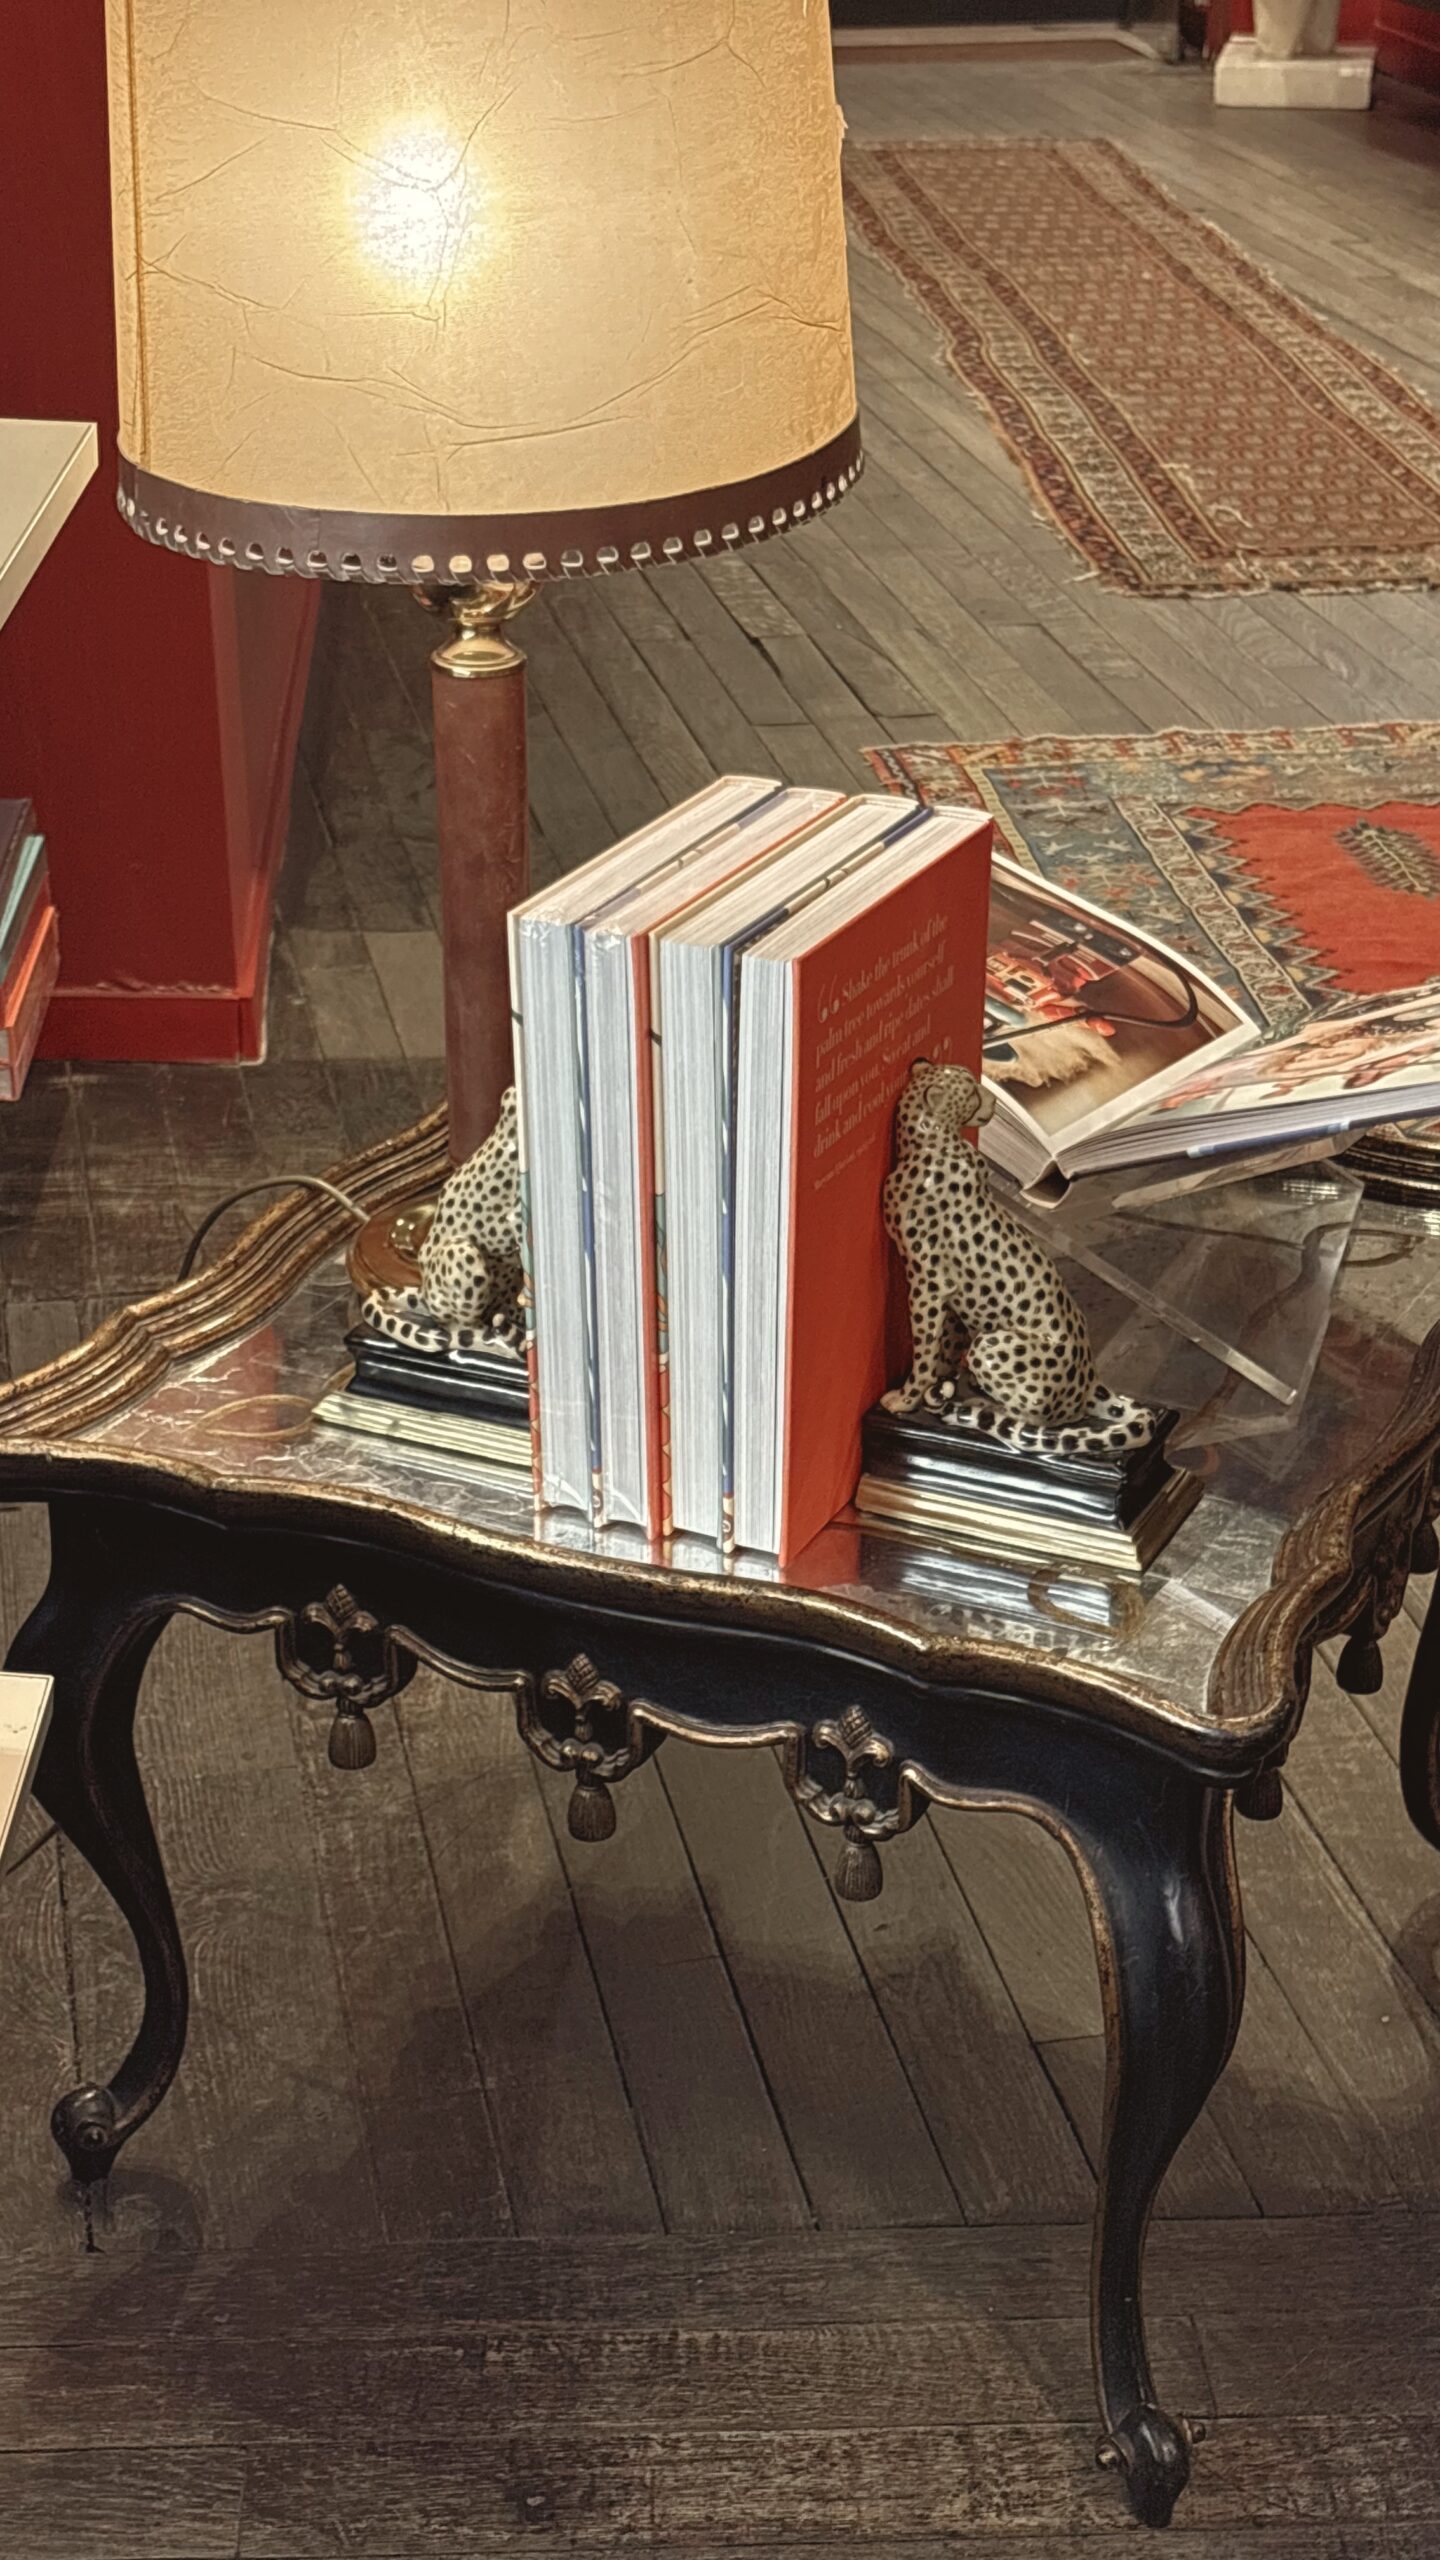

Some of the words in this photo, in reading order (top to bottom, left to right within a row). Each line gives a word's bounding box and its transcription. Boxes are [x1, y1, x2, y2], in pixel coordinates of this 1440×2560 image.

[815, 1094, 831, 1123] fall
[833, 1080, 859, 1114] upon
[912, 1013, 930, 1046] and
[816, 1027, 842, 1067] palm
[816, 1058, 835, 1091] and
[864, 1020, 883, 1052] and
[813, 1120, 841, 1158] drink
[843, 1100, 862, 1133] and
